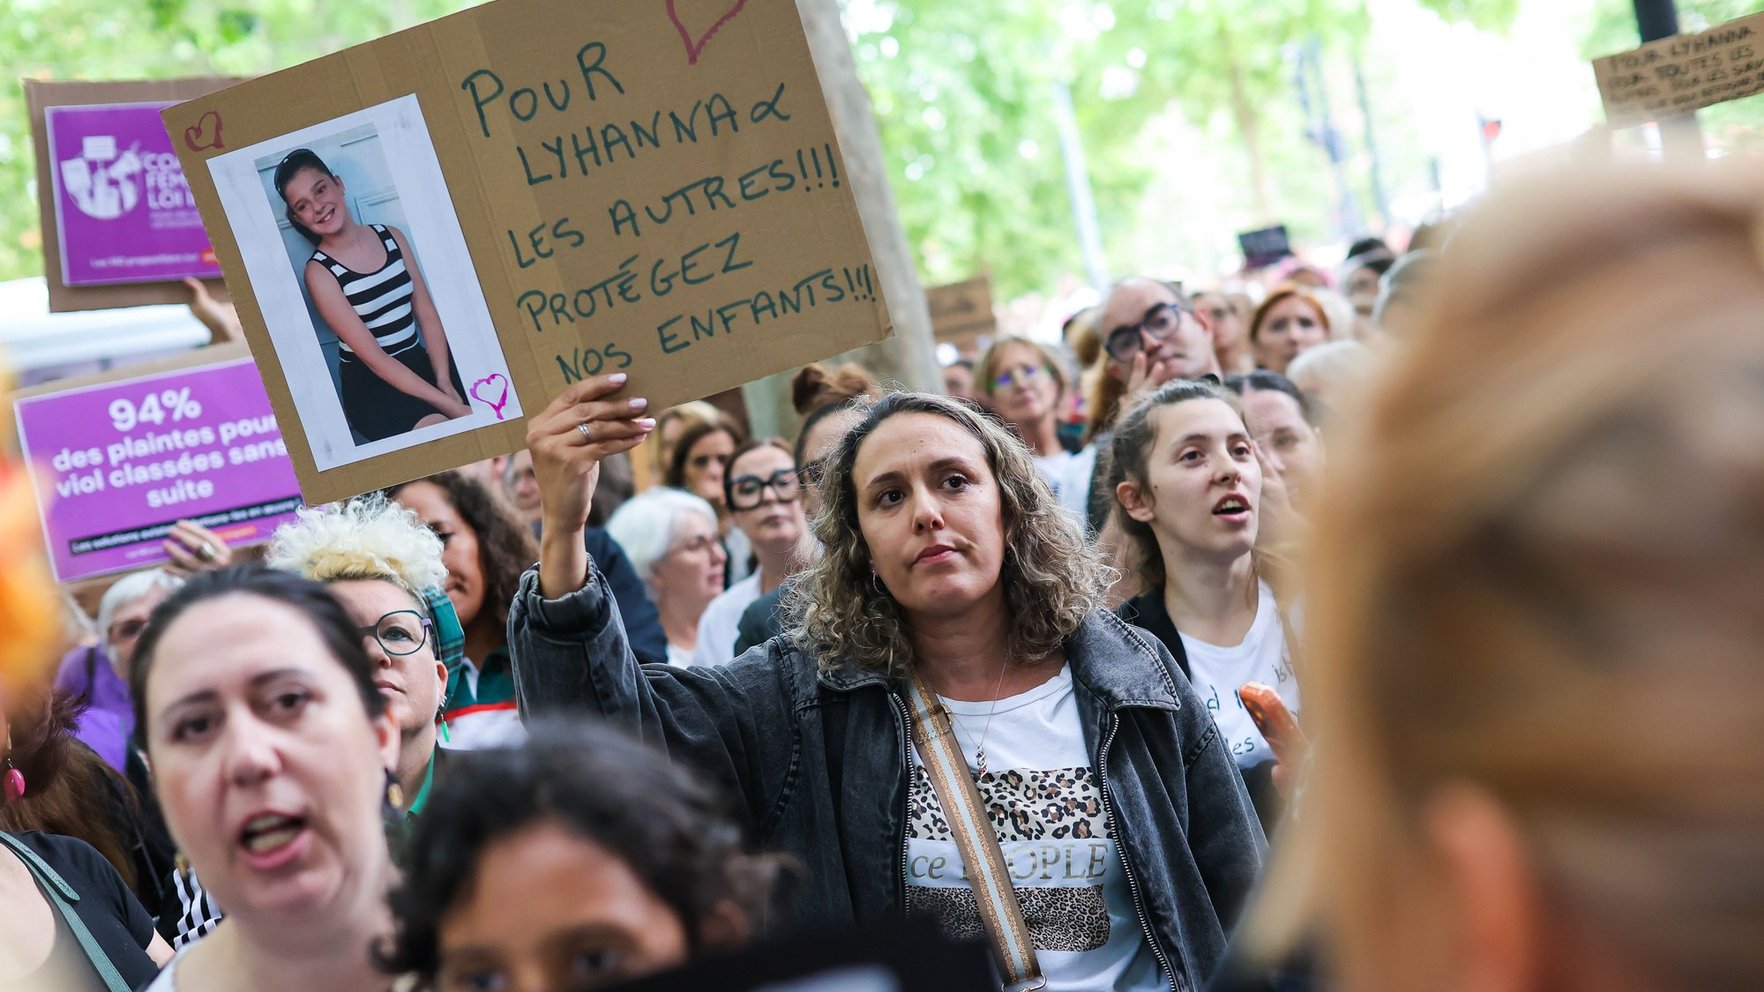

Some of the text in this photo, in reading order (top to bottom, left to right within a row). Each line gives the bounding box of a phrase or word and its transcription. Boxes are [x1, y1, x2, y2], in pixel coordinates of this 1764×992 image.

[516, 93, 739, 185] LYHANNA
[507, 217, 585, 269] LES
[516, 232, 753, 332] PROTÉGEZ
[555, 342, 633, 386] NOS
[108, 387, 202, 432] 94%
[52, 414, 278, 472] des plaintes pour
[56, 437, 290, 498] viol classées sans
[146, 479, 215, 508] suite
